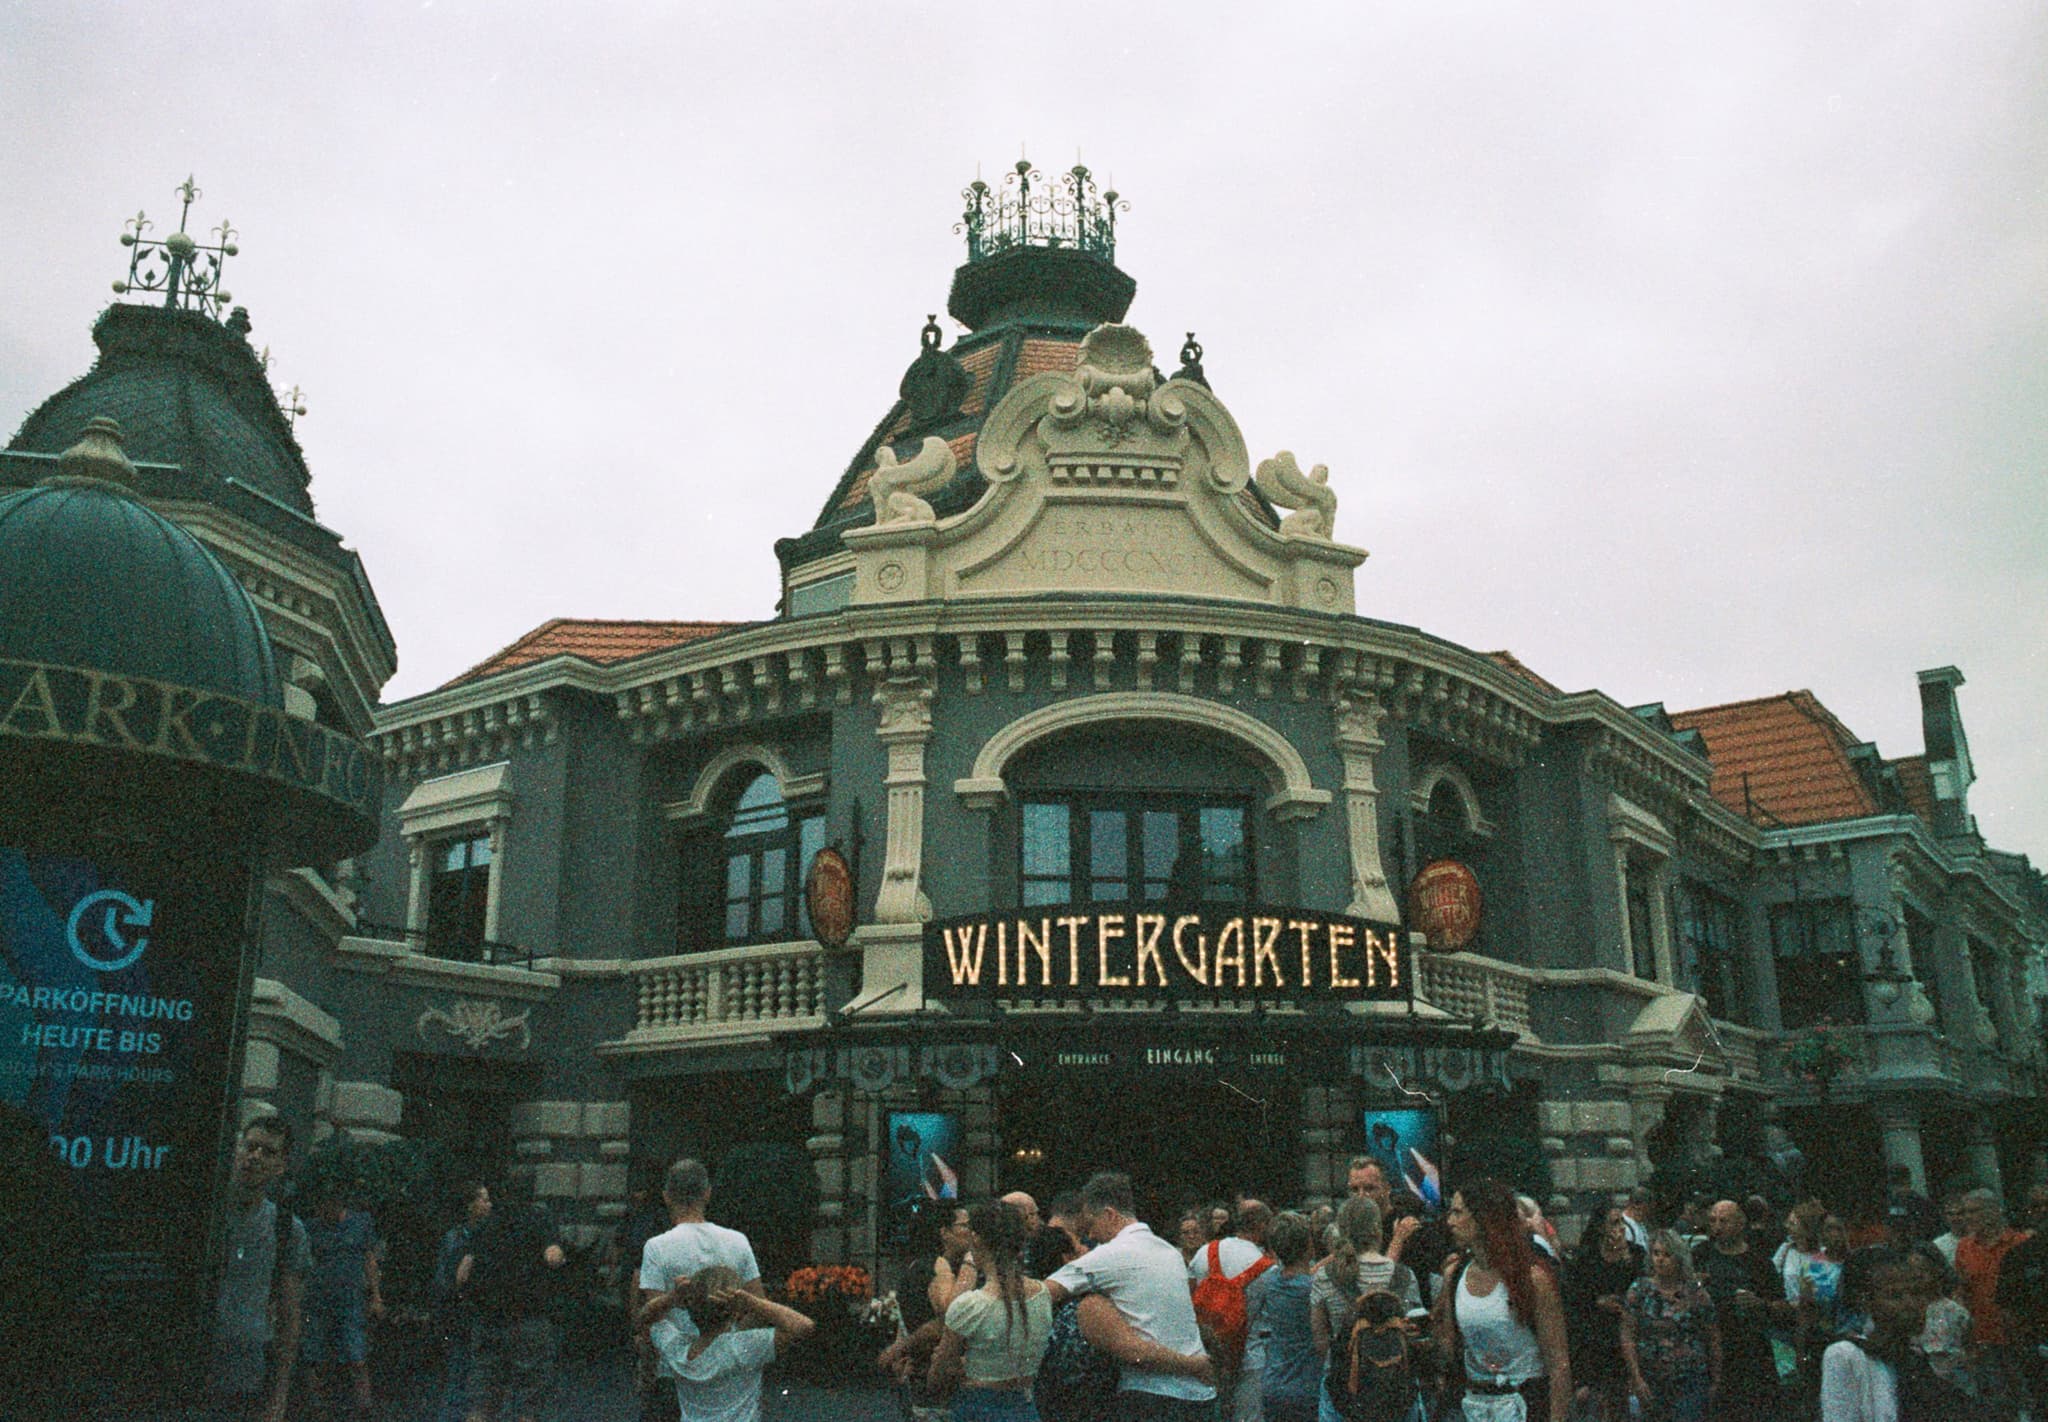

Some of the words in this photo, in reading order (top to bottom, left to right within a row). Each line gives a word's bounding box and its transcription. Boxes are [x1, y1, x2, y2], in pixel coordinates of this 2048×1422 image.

[943, 914, 1400, 988] WINTERGARTEN
[0, 983, 193, 1021] PARKÖFFNUNG
[20, 1023, 113, 1051] HEUTE
[118, 1029, 161, 1053] BIS
[1147, 1048, 1215, 1065] EINGANG
[67, 1063, 113, 1080] PARK
[117, 1066, 175, 1083] HOURS
[104, 1136, 170, 1169] Uhr
